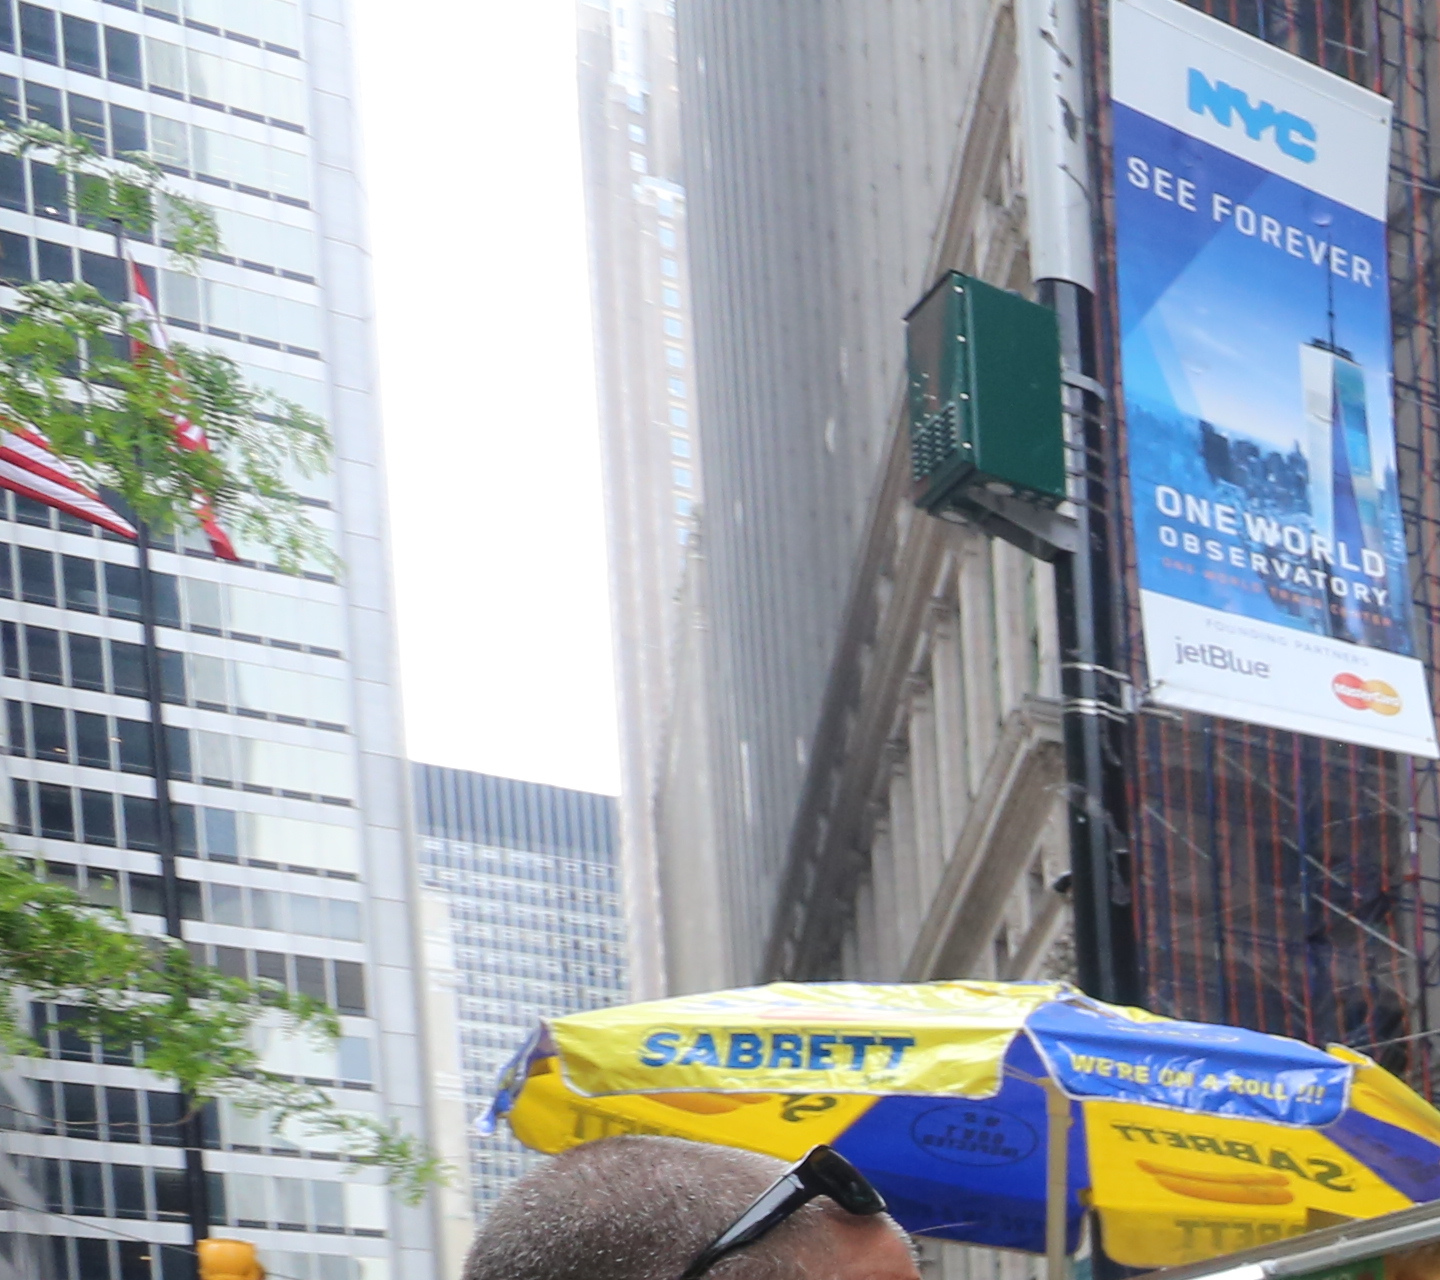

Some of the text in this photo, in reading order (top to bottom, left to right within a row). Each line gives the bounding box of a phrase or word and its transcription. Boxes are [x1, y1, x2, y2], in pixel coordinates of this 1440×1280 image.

[1186, 66, 1318, 165] NYC
[1126, 155, 1373, 289] SEE FOREVER
[1155, 485, 1386, 578] ONE WORLD
[1159, 526, 1388, 606] OBSERVATORY
[1174, 636, 1270, 679] jetBlue
[640, 1031, 915, 1070] SABRETT
[1069, 1055, 1149, 1084] WE'RE
[1158, 1067, 1195, 1088] ON
[1202, 1073, 1224, 1090] A
[1228, 1073, 1288, 1101] ROLL
